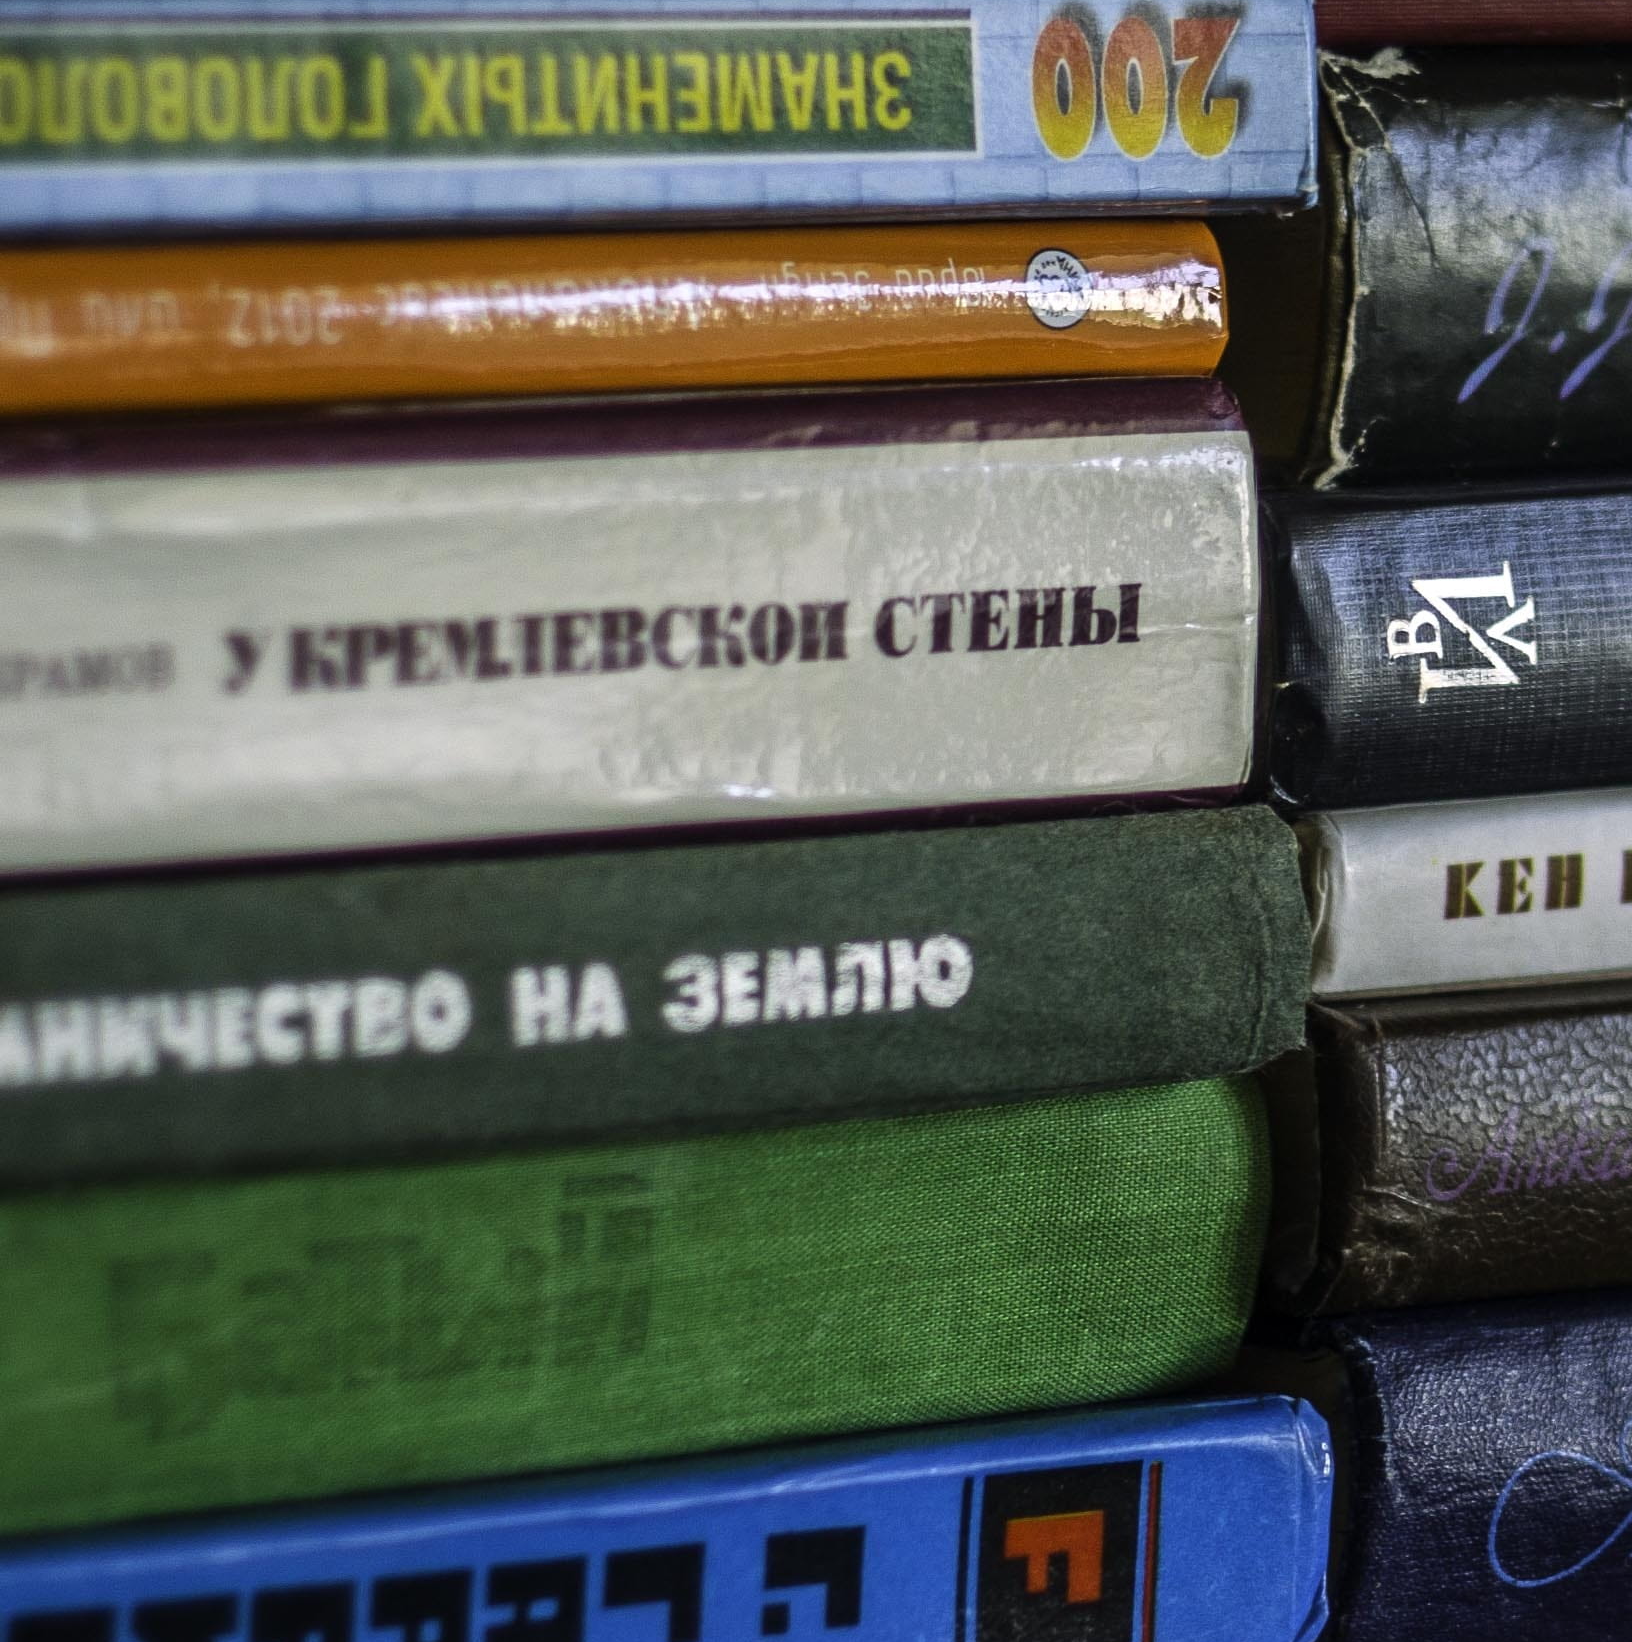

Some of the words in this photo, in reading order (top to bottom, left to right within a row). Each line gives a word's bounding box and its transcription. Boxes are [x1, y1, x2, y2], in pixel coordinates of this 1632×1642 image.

[409, 48, 913, 141] ЗНАМЕНИТЫХ
[1031, 16, 1241, 160] 200
[219, 633, 272, 694] У
[873, 581, 1143, 658] СТЕНЫ
[1444, 854, 1585, 922] КЕН
[511, 964, 626, 1046] НА
[662, 934, 973, 1033] ЗЕМЛЮ
